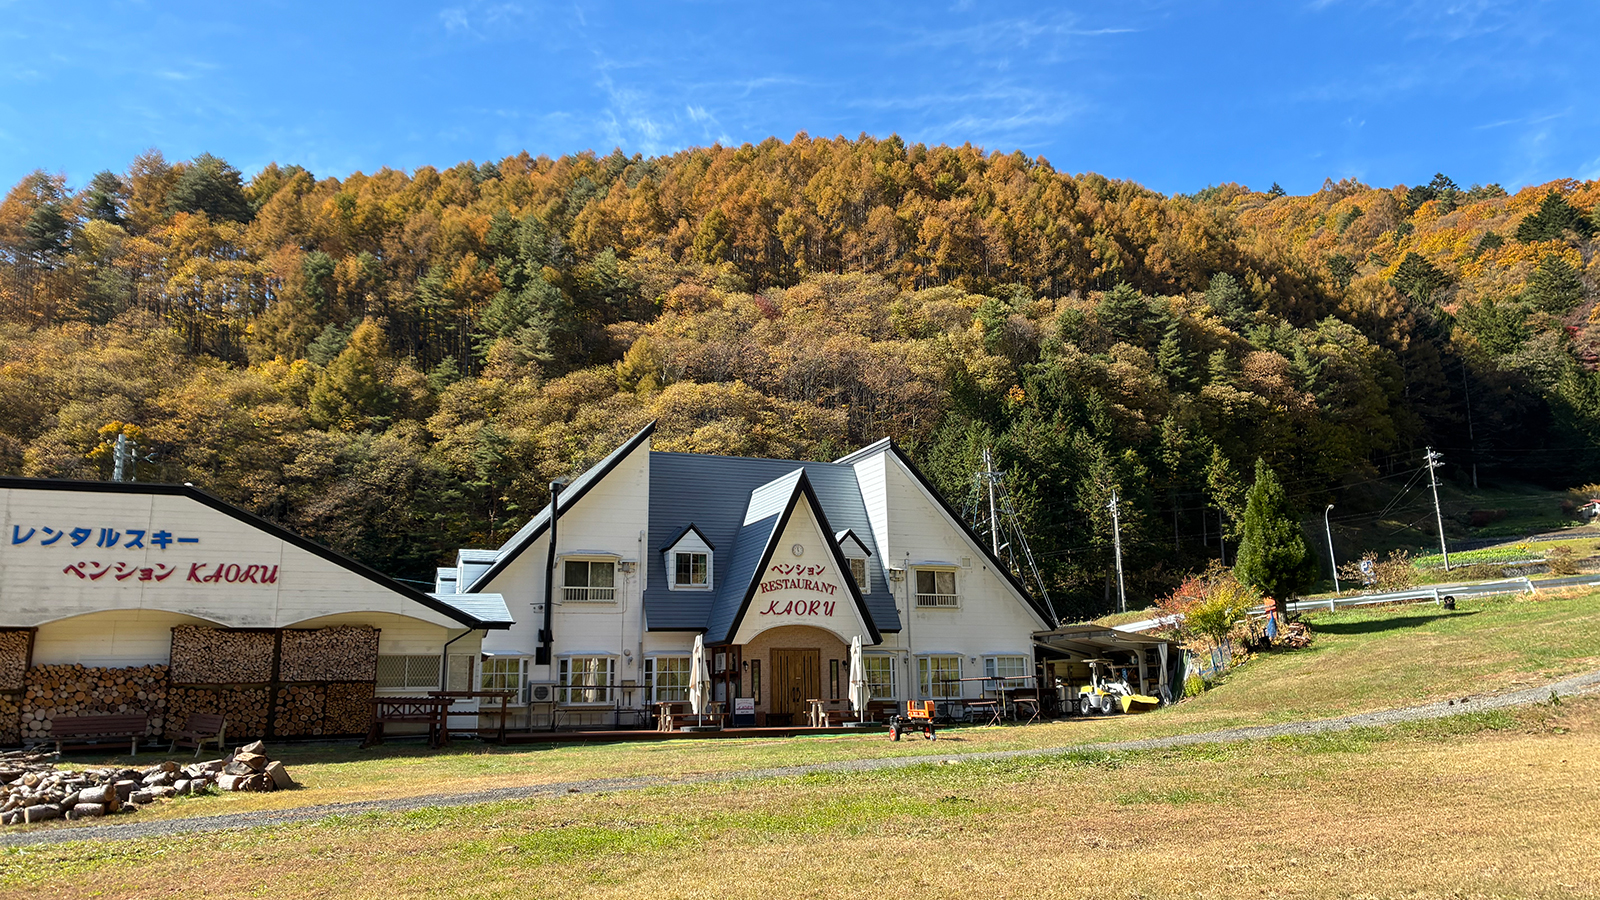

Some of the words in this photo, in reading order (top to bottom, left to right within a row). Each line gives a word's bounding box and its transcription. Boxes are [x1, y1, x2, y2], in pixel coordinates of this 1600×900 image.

[11, 524, 200, 550] レンタルスキー
[62, 561, 177, 582] ペンション
[186, 562, 279, 584] KAORU
[771, 563, 826, 577] ペンション
[760, 578, 837, 596] RESTAURANT
[760, 599, 836, 617] KAORU
